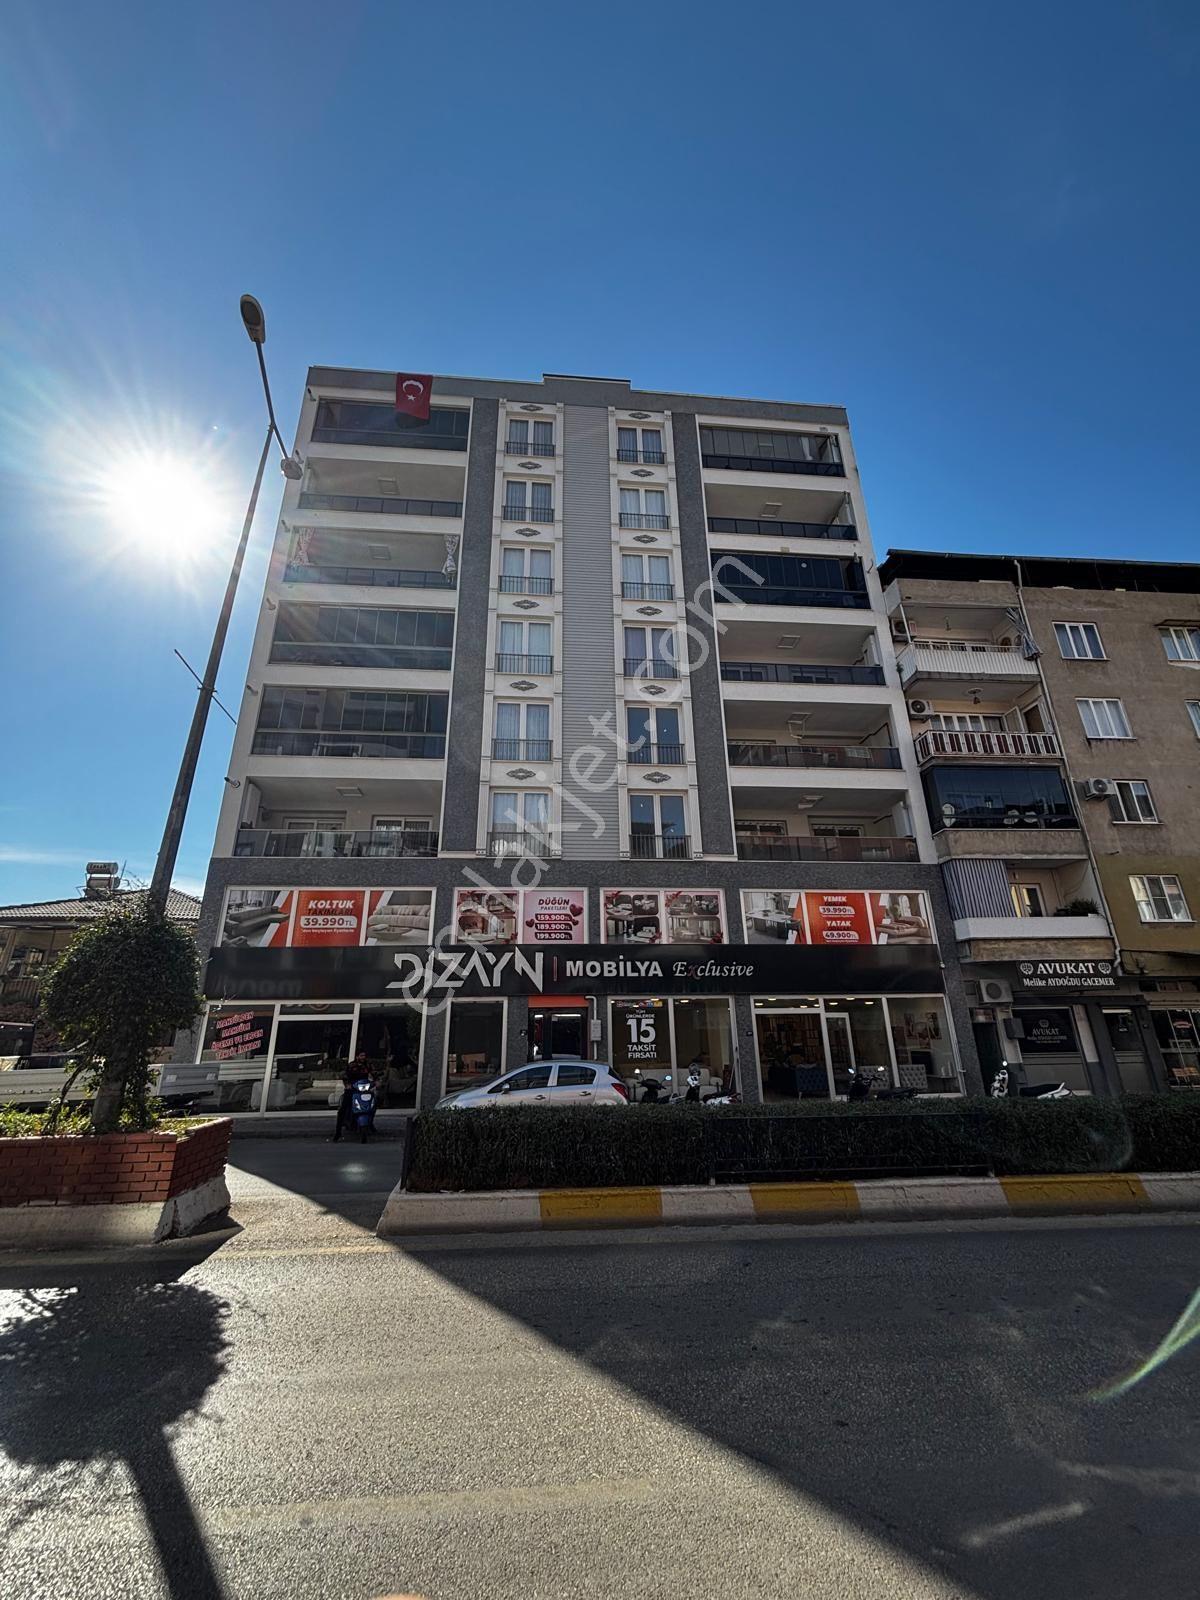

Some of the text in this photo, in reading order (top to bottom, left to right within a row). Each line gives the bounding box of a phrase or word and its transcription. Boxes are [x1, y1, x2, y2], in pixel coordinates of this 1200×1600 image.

[308, 900, 354, 909] KOLTUK
[538, 897, 570, 905] DÜĞÜN
[565, 955, 663, 977] MOBİLYA
[672, 961, 754, 980] Exclusive
[1037, 962, 1095, 974] AVUKAT
[1023, 976, 1115, 986] Melike AYDOĞDU GACEMER
[626, 1018, 656, 1043] 15
[1032, 1028, 1059, 1036] AVUKAT
[627, 1043, 656, 1052] TAKSİT
[628, 1051, 657, 1059] FIRSATI
